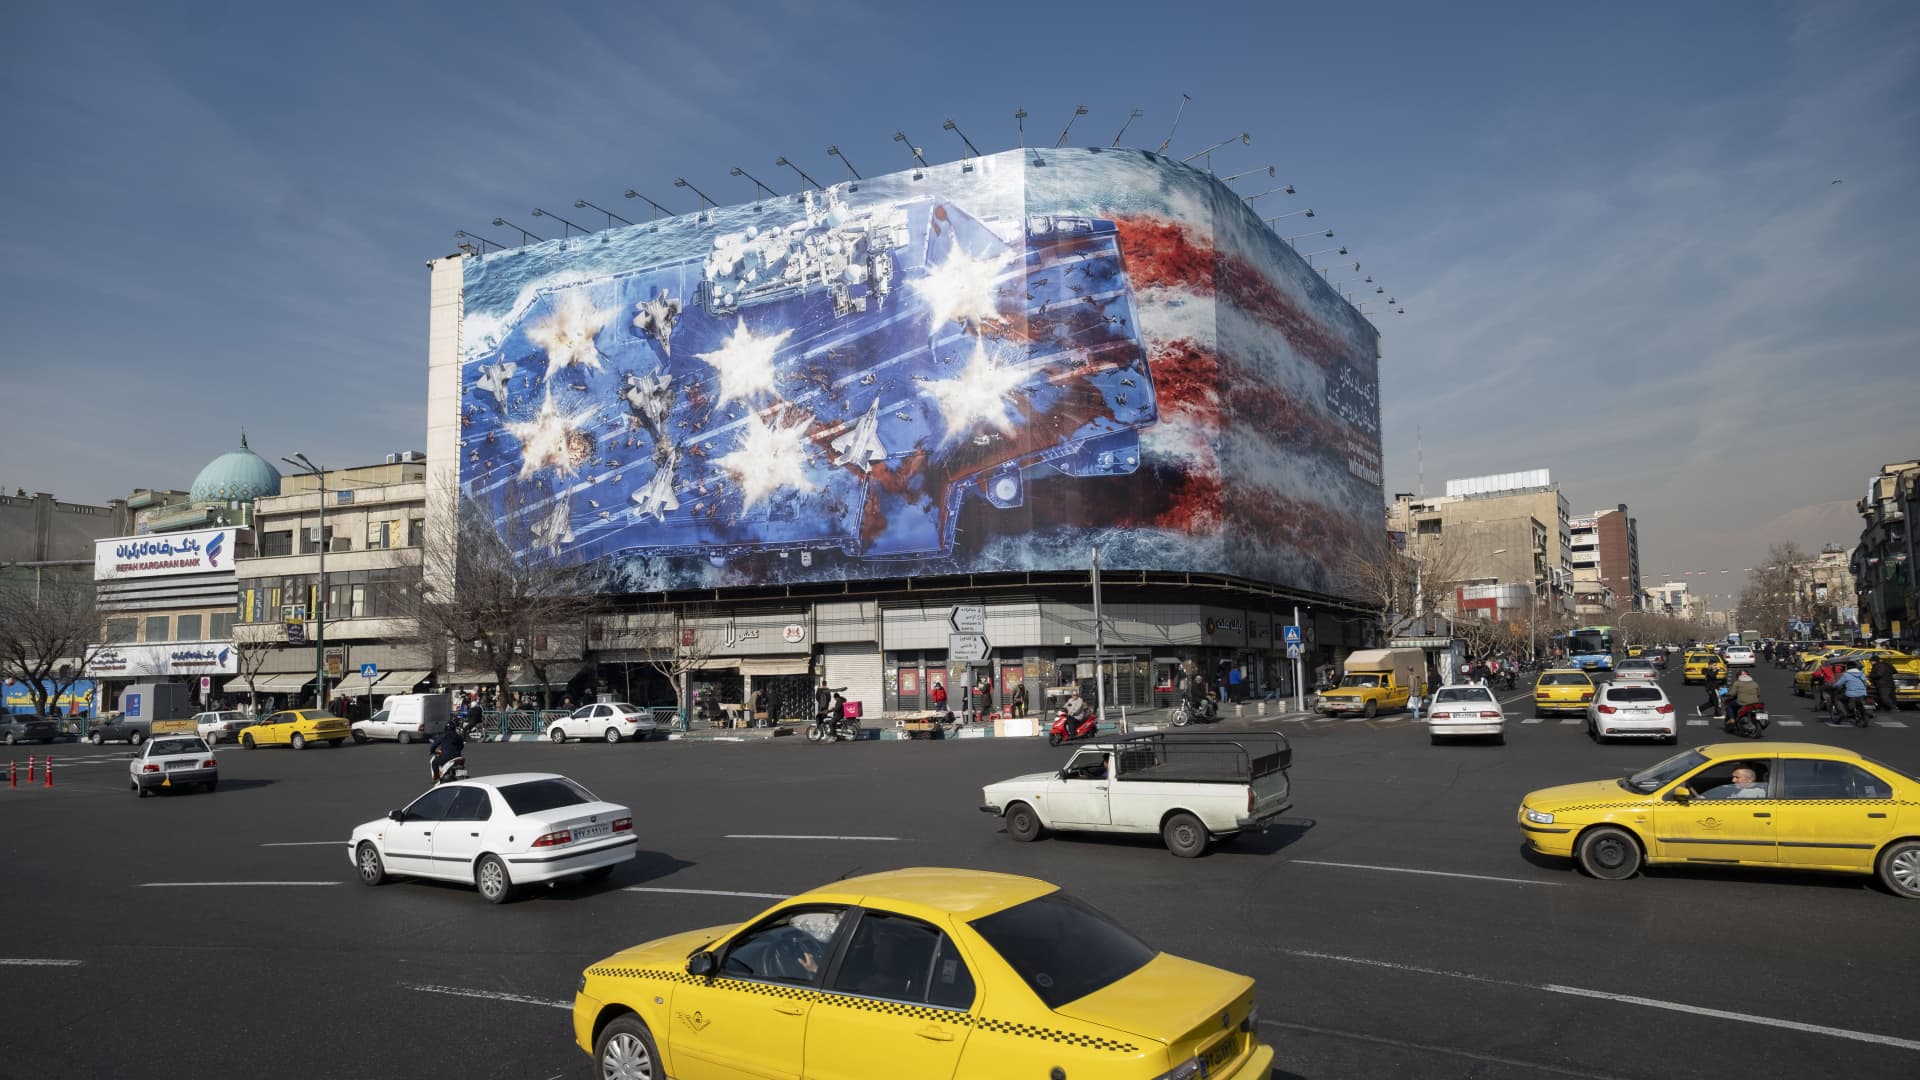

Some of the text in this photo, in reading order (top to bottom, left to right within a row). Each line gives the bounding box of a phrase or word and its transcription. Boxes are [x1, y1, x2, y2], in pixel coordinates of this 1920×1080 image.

[116, 537, 201, 559] بانک رفاه کارگران
[116, 558, 201, 572] REFAH KARGARAN BANK
